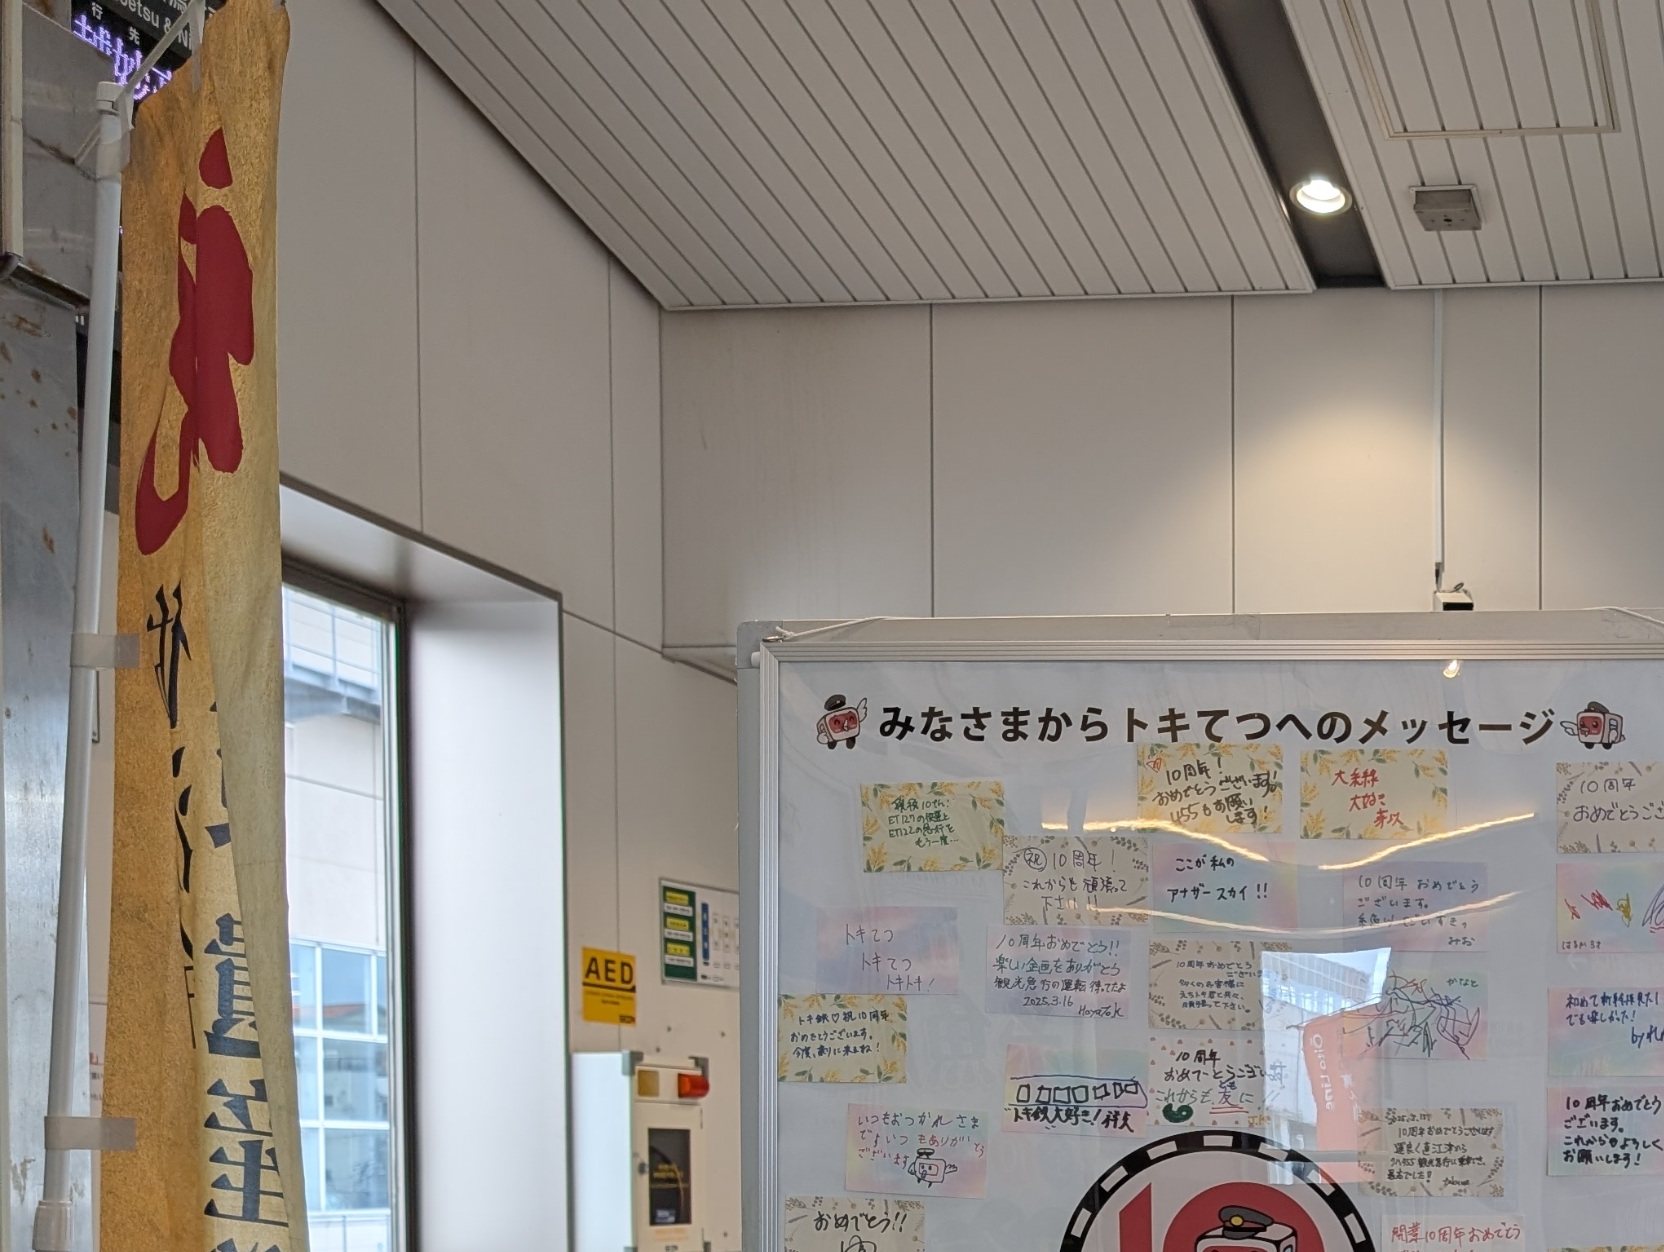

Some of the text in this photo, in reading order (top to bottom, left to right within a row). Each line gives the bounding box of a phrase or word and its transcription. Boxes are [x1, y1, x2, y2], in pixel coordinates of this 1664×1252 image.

[879, 706, 1556, 745] みなさまからトキてつへのメッセージ
[585, 957, 633, 985] AED
